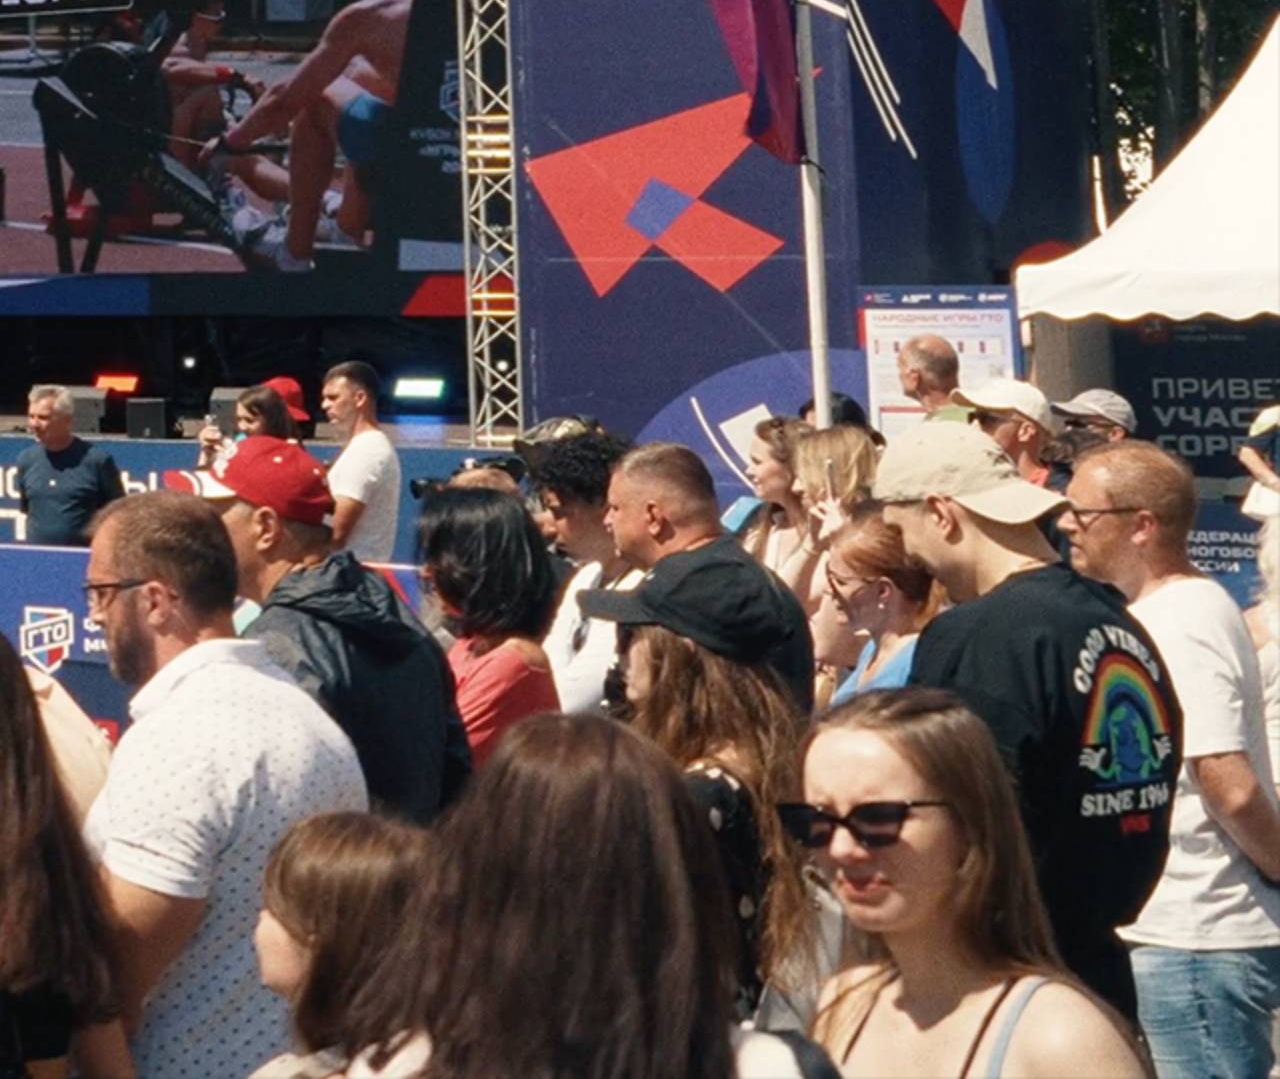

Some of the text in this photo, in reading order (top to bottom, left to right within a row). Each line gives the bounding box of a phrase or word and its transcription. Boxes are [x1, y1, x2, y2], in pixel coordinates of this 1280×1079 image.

[1152, 377, 1280, 399] ПРИВЕ
[1152, 405, 1260, 429] УЧАС
[1156, 433, 1250, 457] СОР
[1187, 530, 1256, 544] ЕДЕРАЦ
[1186, 546, 1255, 559] НОГОБО
[28, 622, 66, 648] ГТО
